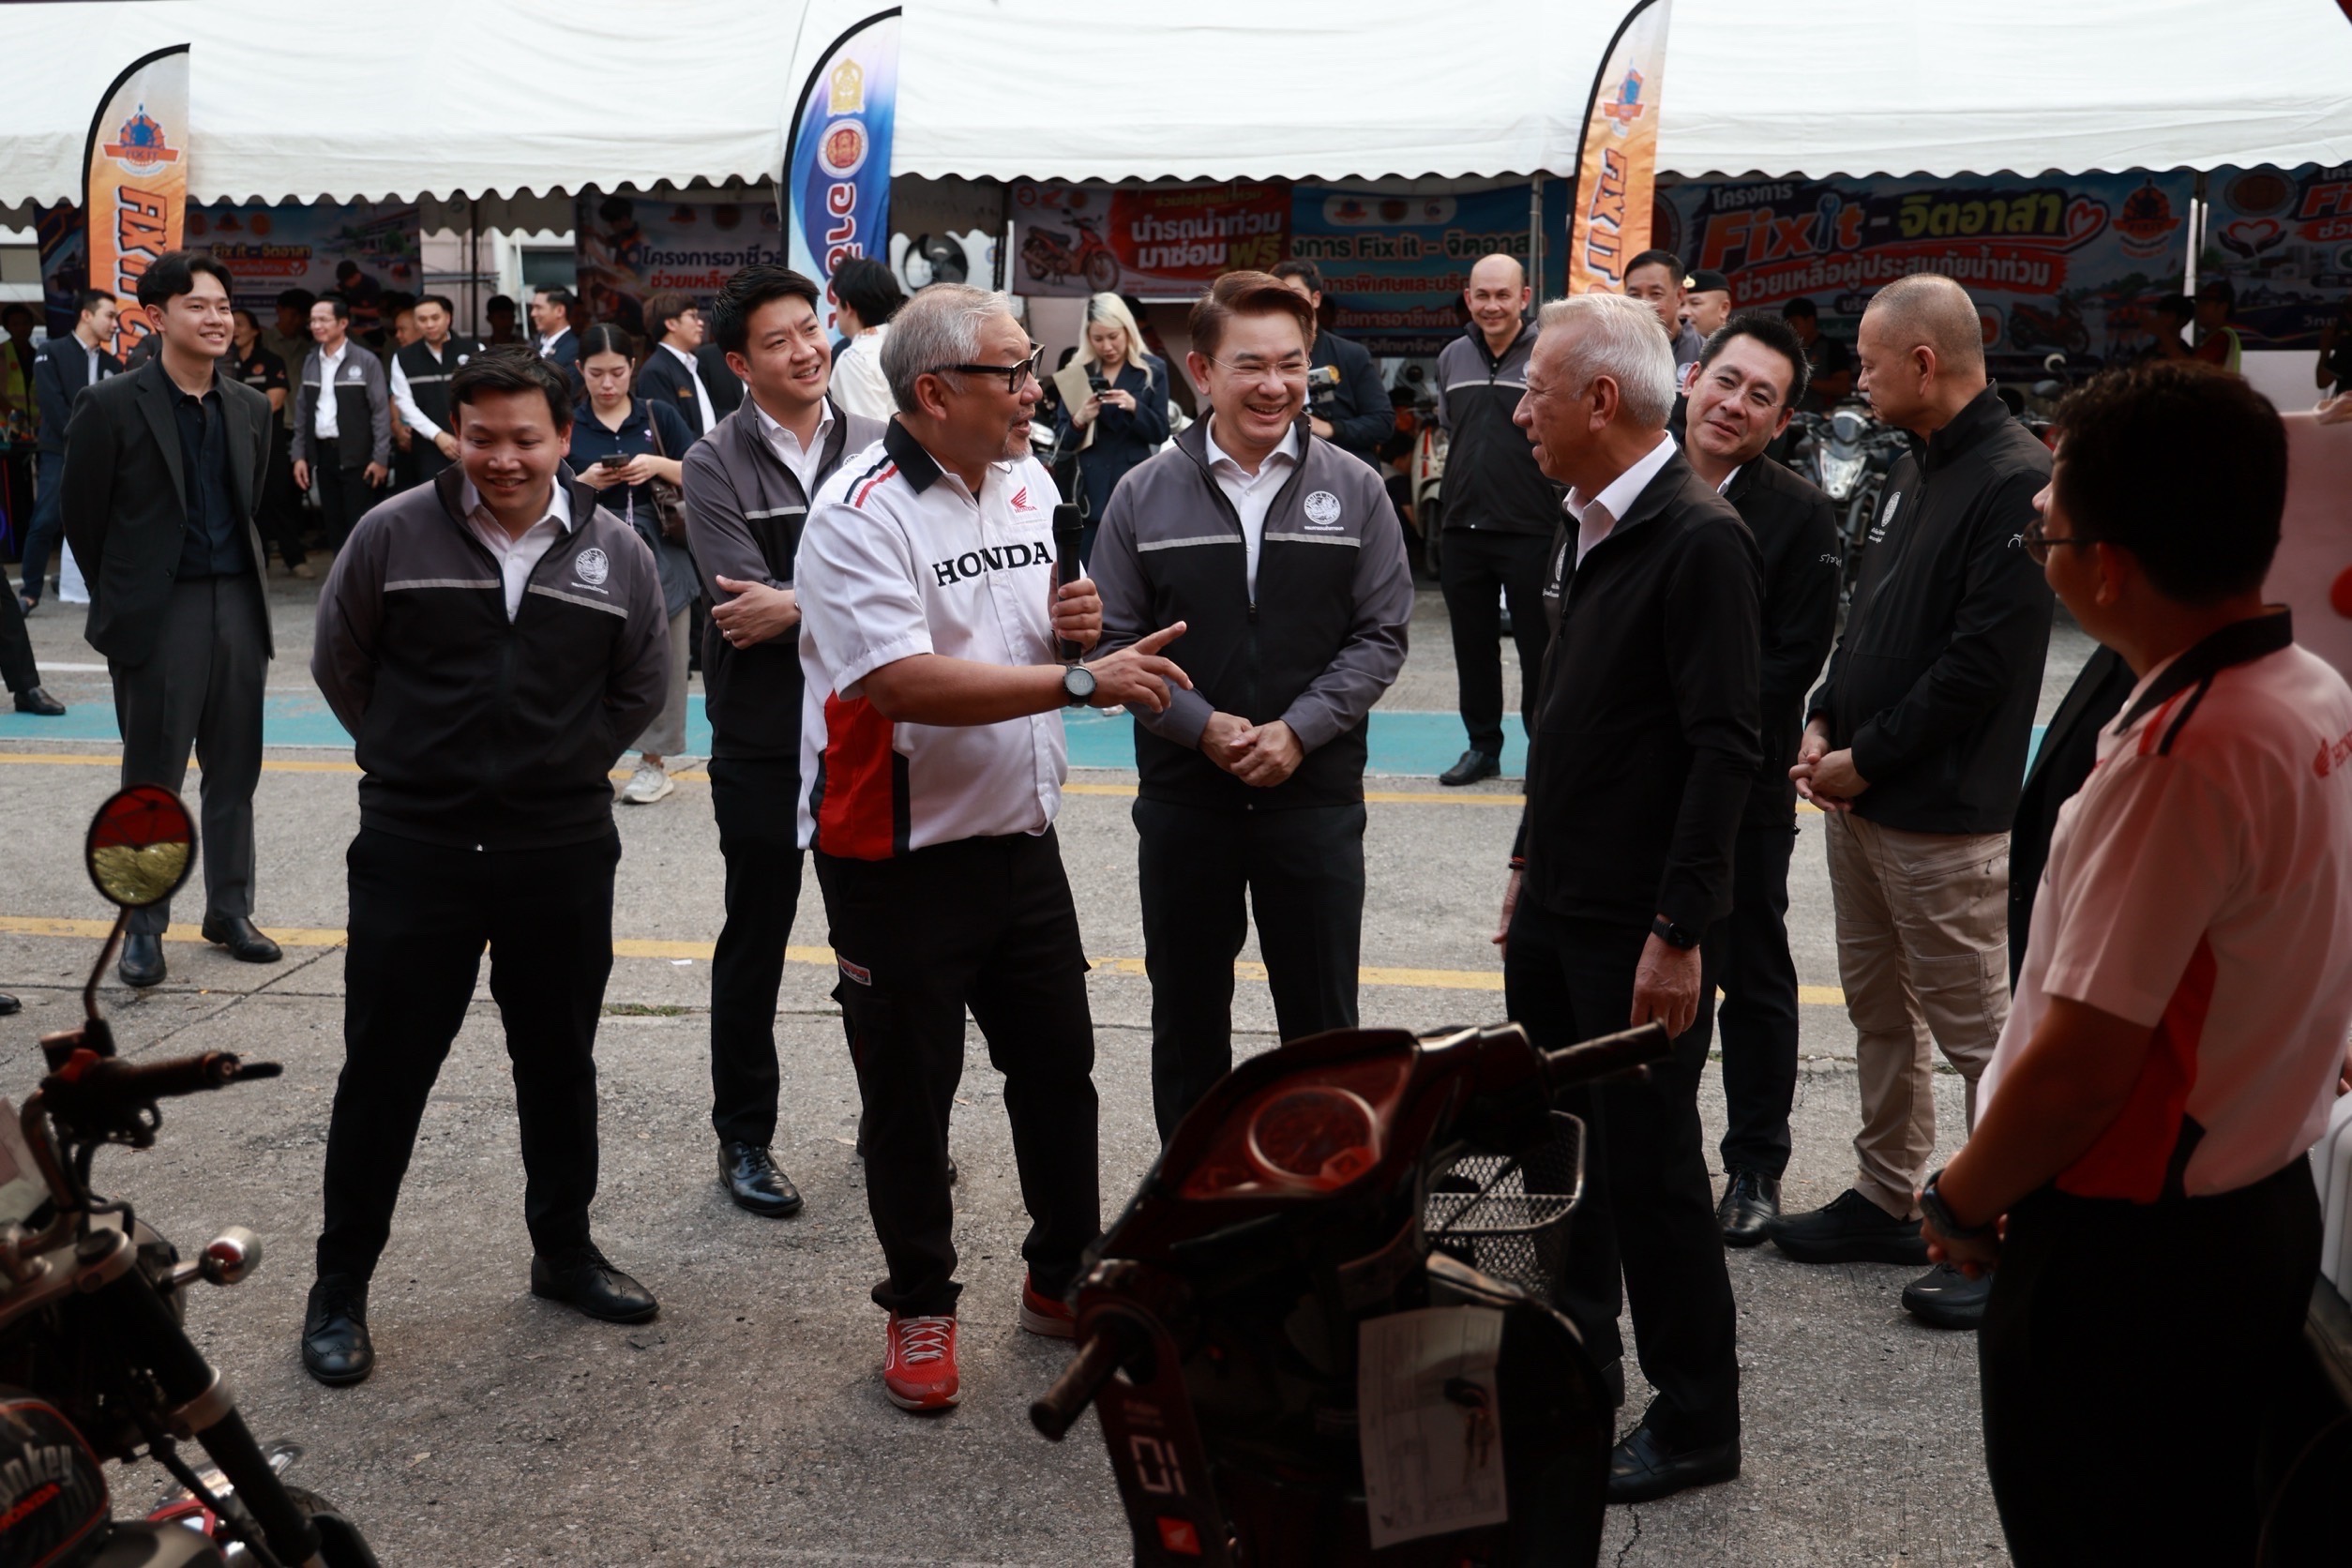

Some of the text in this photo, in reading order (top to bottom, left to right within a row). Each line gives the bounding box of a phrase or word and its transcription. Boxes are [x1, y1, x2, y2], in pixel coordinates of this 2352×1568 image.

[1589, 148, 1627, 233] FIX
[1711, 183, 1794, 211] โครงการ
[114, 186, 167, 257] FIX
[1131, 207, 1282, 243] นำรถน้ำท่วม
[1898, 193, 2062, 238] จิตอาสา
[1138, 234, 1283, 269] มาซ่อม ฟรี
[1357, 236, 1395, 257] Fix
[1402, 235, 1419, 257] it
[1446, 232, 1545, 256] จิตอาส
[1585, 229, 1622, 286] IT
[932, 541, 1053, 588] HONDA
